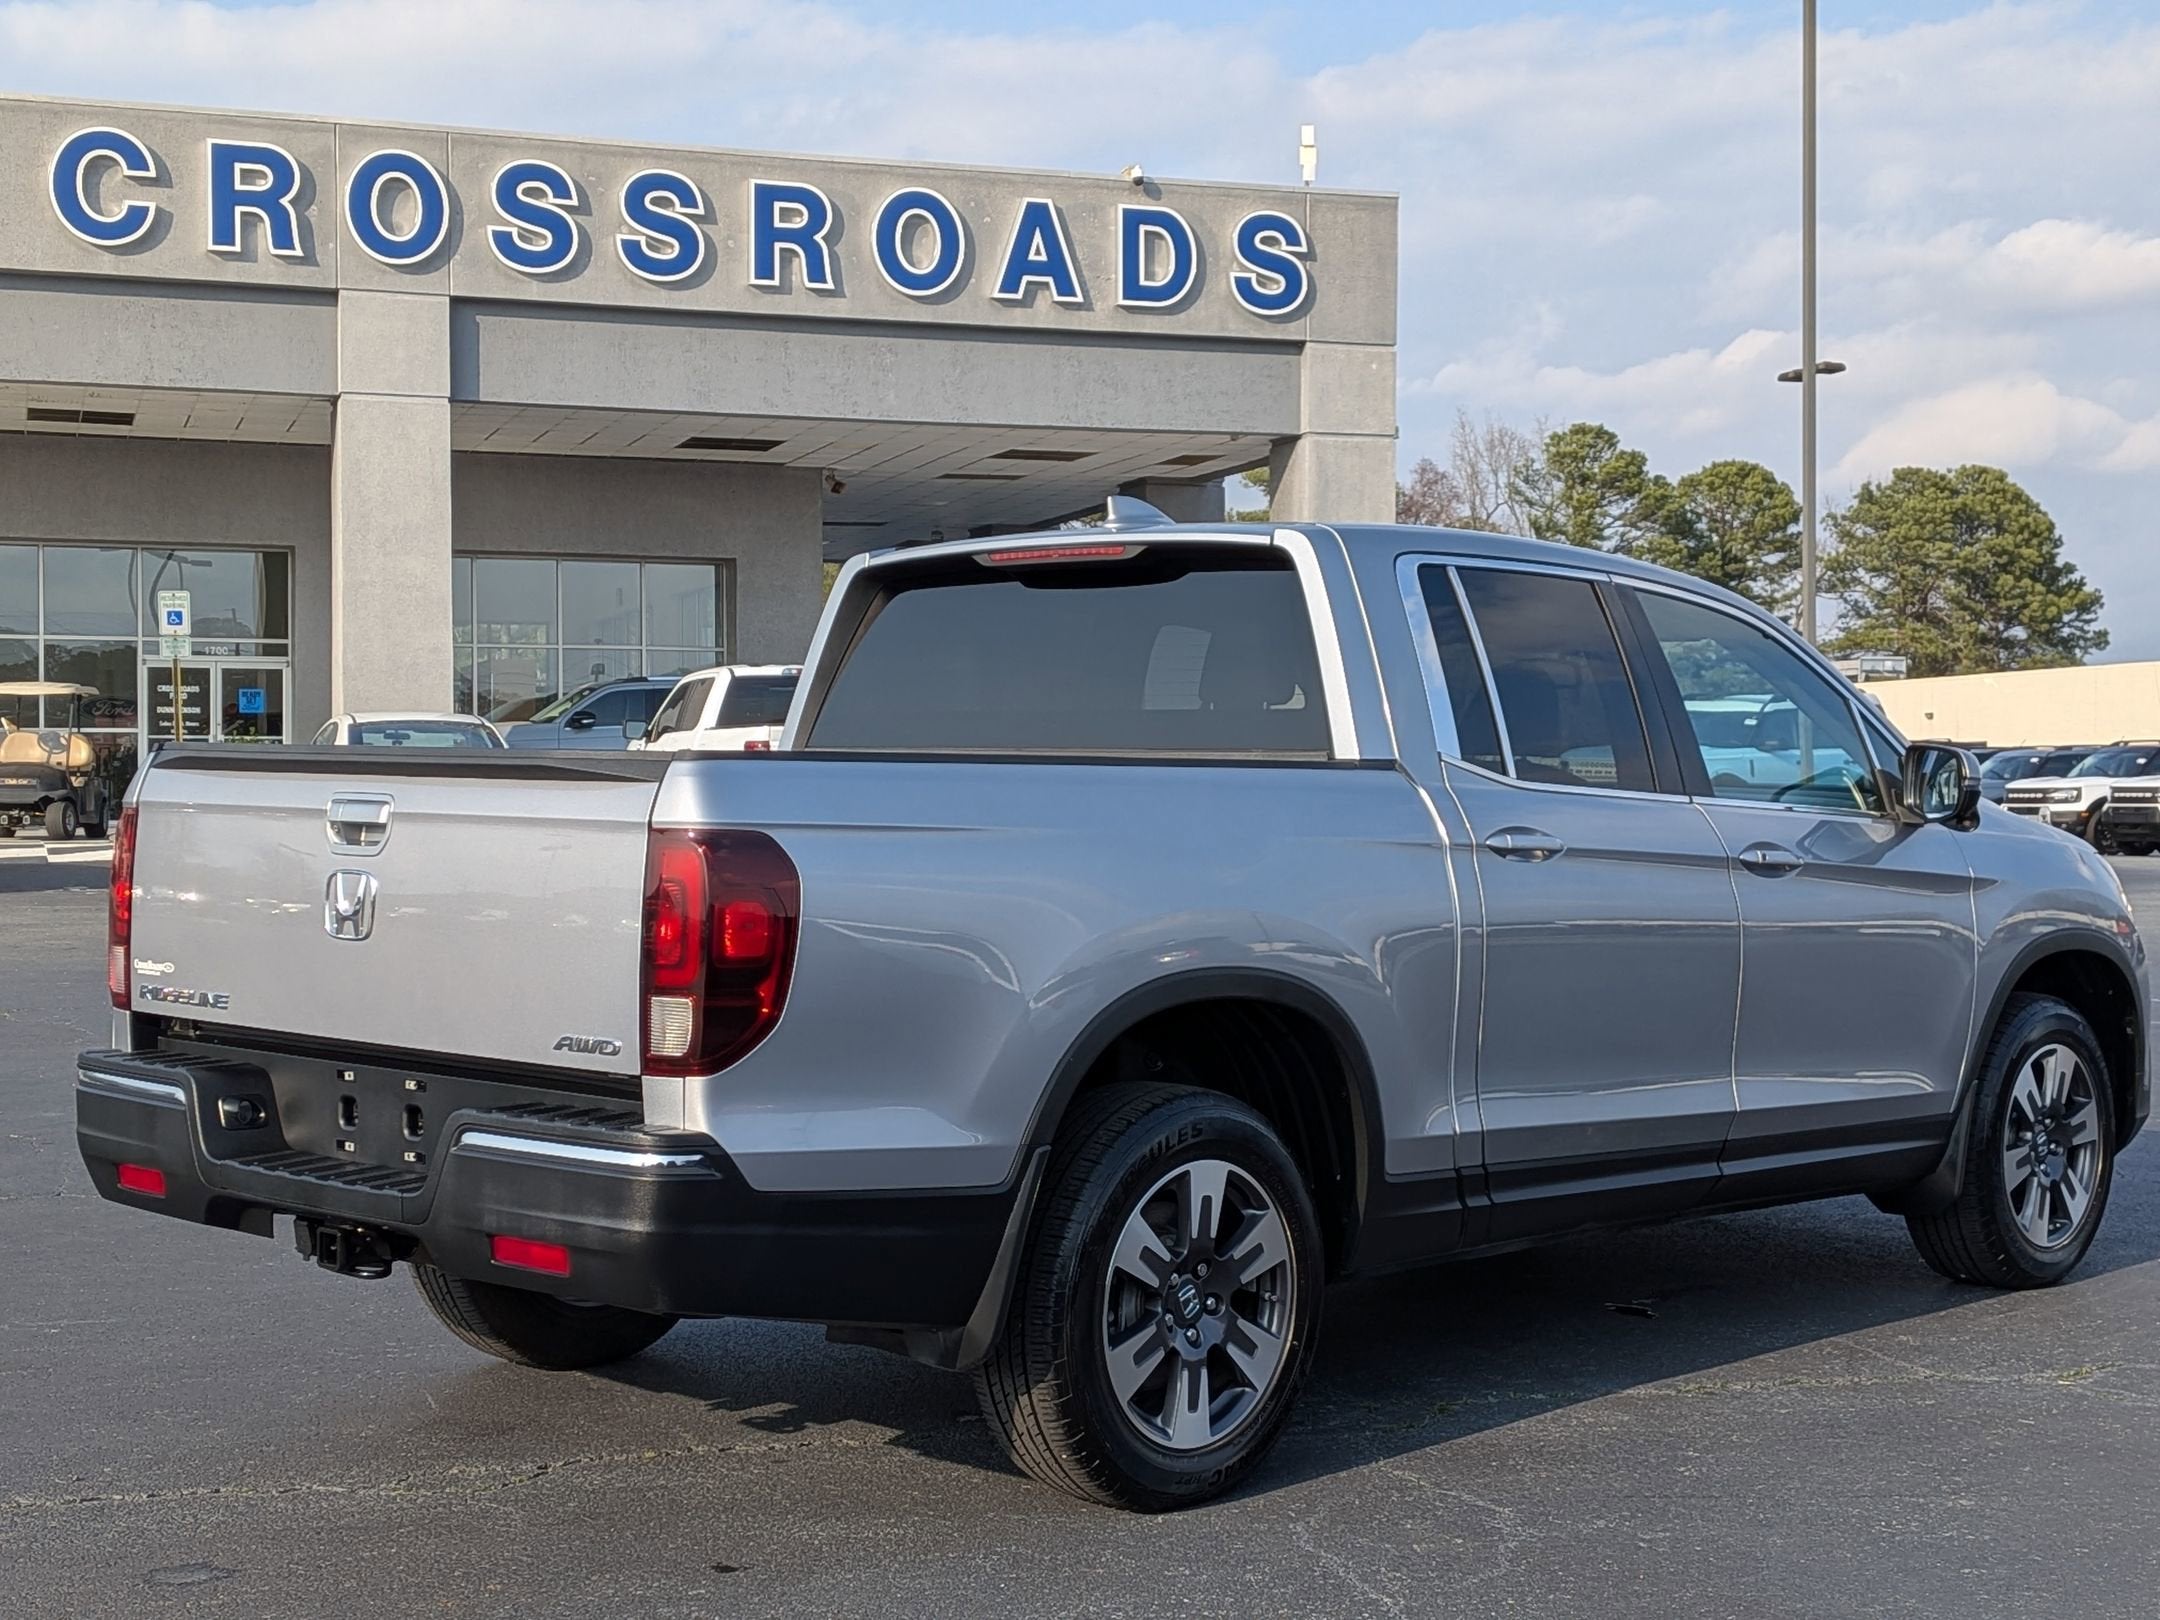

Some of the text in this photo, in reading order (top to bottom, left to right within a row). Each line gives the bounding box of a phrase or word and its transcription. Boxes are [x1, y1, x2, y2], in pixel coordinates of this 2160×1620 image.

[50, 126, 1309, 316] CROSSROADS
[204, 646, 229, 655] 1700
[91, 699, 136, 716] Ford
[552, 1034, 622, 1056] AWD
